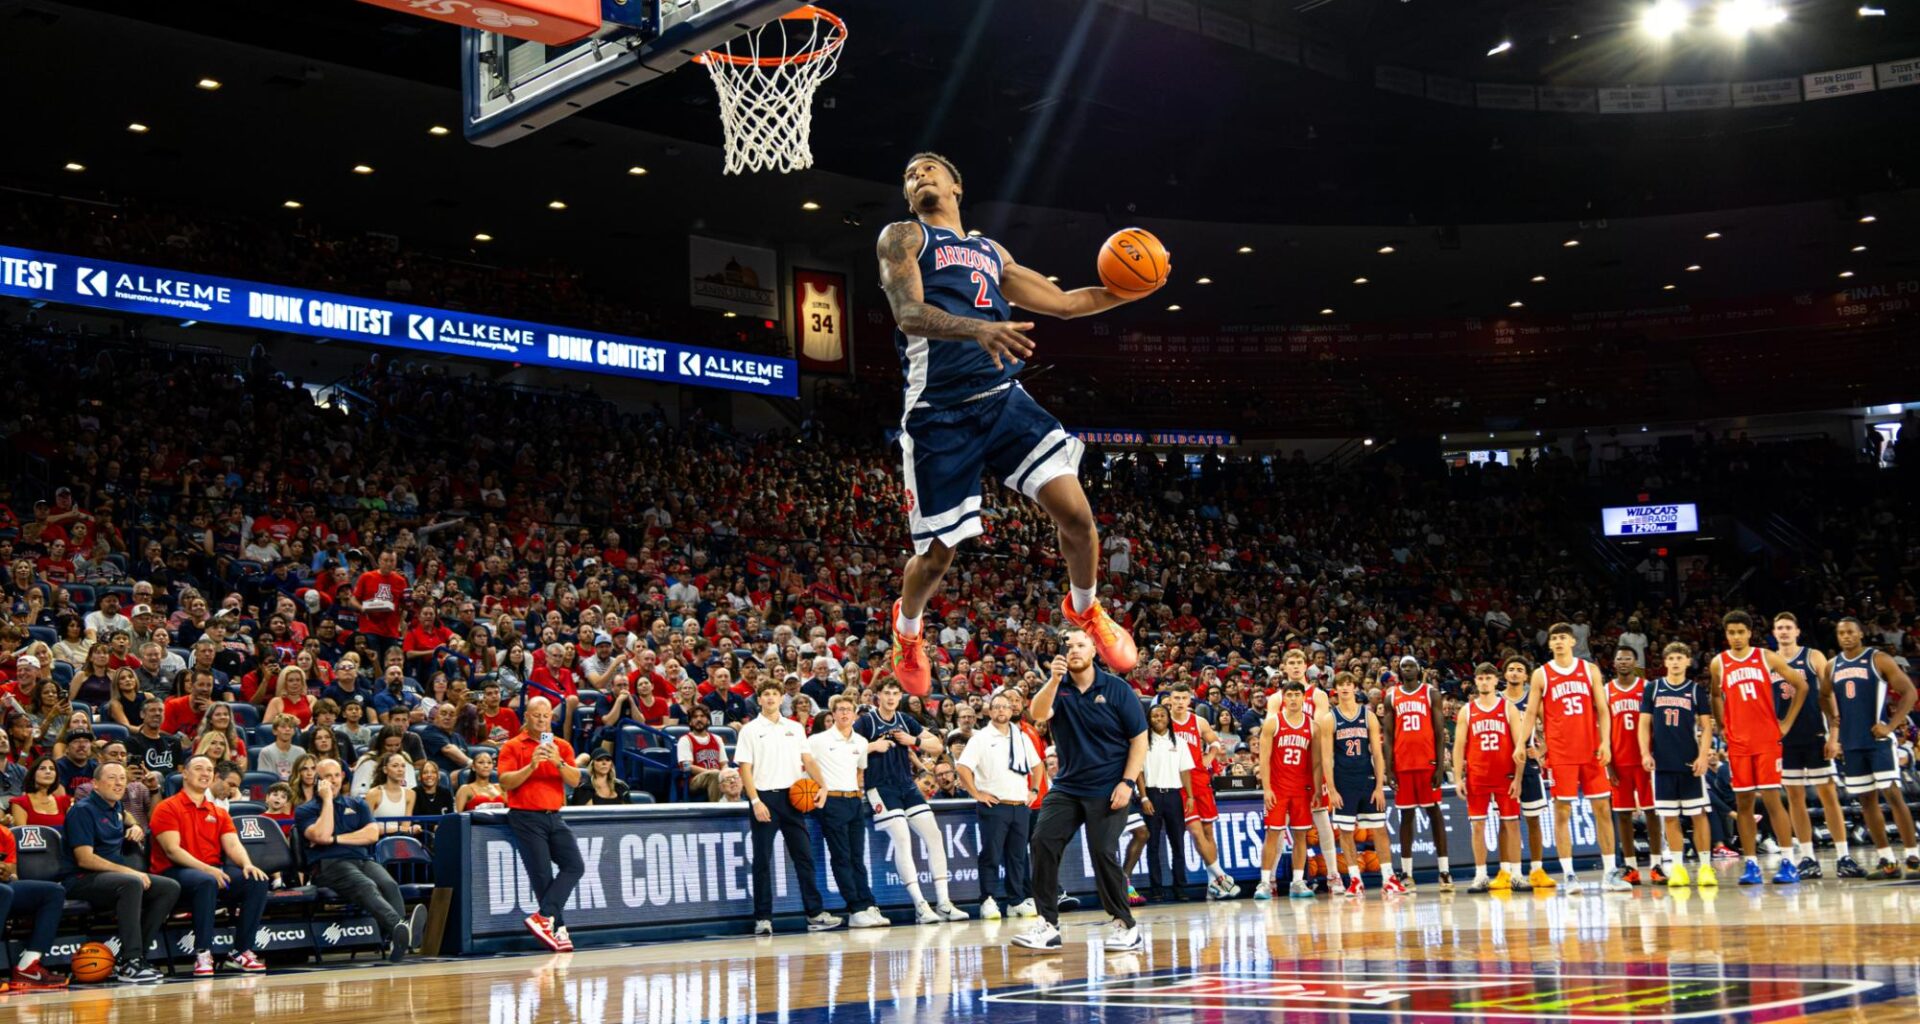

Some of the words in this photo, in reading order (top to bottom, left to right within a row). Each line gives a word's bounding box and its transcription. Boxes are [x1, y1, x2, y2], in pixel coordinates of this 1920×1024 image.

[1814, 75, 1834, 86] SEAN
[0, 256, 57, 291] TEST
[935, 245, 999, 286] ARIZONA
[115, 274, 231, 303] ALKEME
[970, 270, 993, 307] 2
[1841, 285, 1890, 301] FINAL
[115, 290, 159, 303] Insurance
[160, 297, 212, 311] everything.
[1835, 304, 1868, 316] 1988
[249, 292, 303, 324] DUNK
[309, 300, 392, 336] CONTEST
[811, 313, 834, 334] 34
[439, 318, 535, 346] ALKEME
[548, 334, 593, 364] DUNK
[597, 342, 666, 372] CONTEST
[705, 356, 783, 379] ALKEME
[1077, 432, 1144, 443] ARIZONA
[1151, 433, 1224, 445] WILDCATS
[1627, 506, 1679, 517] WILDCATS
[1648, 515, 1677, 523] RADIO
[1726, 667, 1765, 688] ARIZONA
[1551, 681, 1591, 702] ARIZONA
[1738, 682, 1758, 701] 14
[1845, 680, 1857, 699] 0
[1396, 700, 1427, 716] ARIZONA
[1562, 696, 1584, 716] 35
[1611, 699, 1640, 717] ARIZON
[1403, 714, 1421, 731] 20
[1624, 713, 1635, 730] 6
[1663, 708, 1680, 727] 11
[1472, 719, 1506, 736] ARIZONA
[1278, 734, 1310, 751] ARIZONA
[1345, 739, 1362, 756] 21
[1480, 733, 1500, 751] 22
[145, 746, 174, 769] Cats
[1283, 748, 1301, 765] 23
[240, 816, 265, 840] A
[19, 828, 47, 849] A
[487, 837, 607, 915] DUK
[271, 929, 306, 942] ICCU
[341, 925, 374, 938] ICCU
[45, 943, 82, 957] CCU
